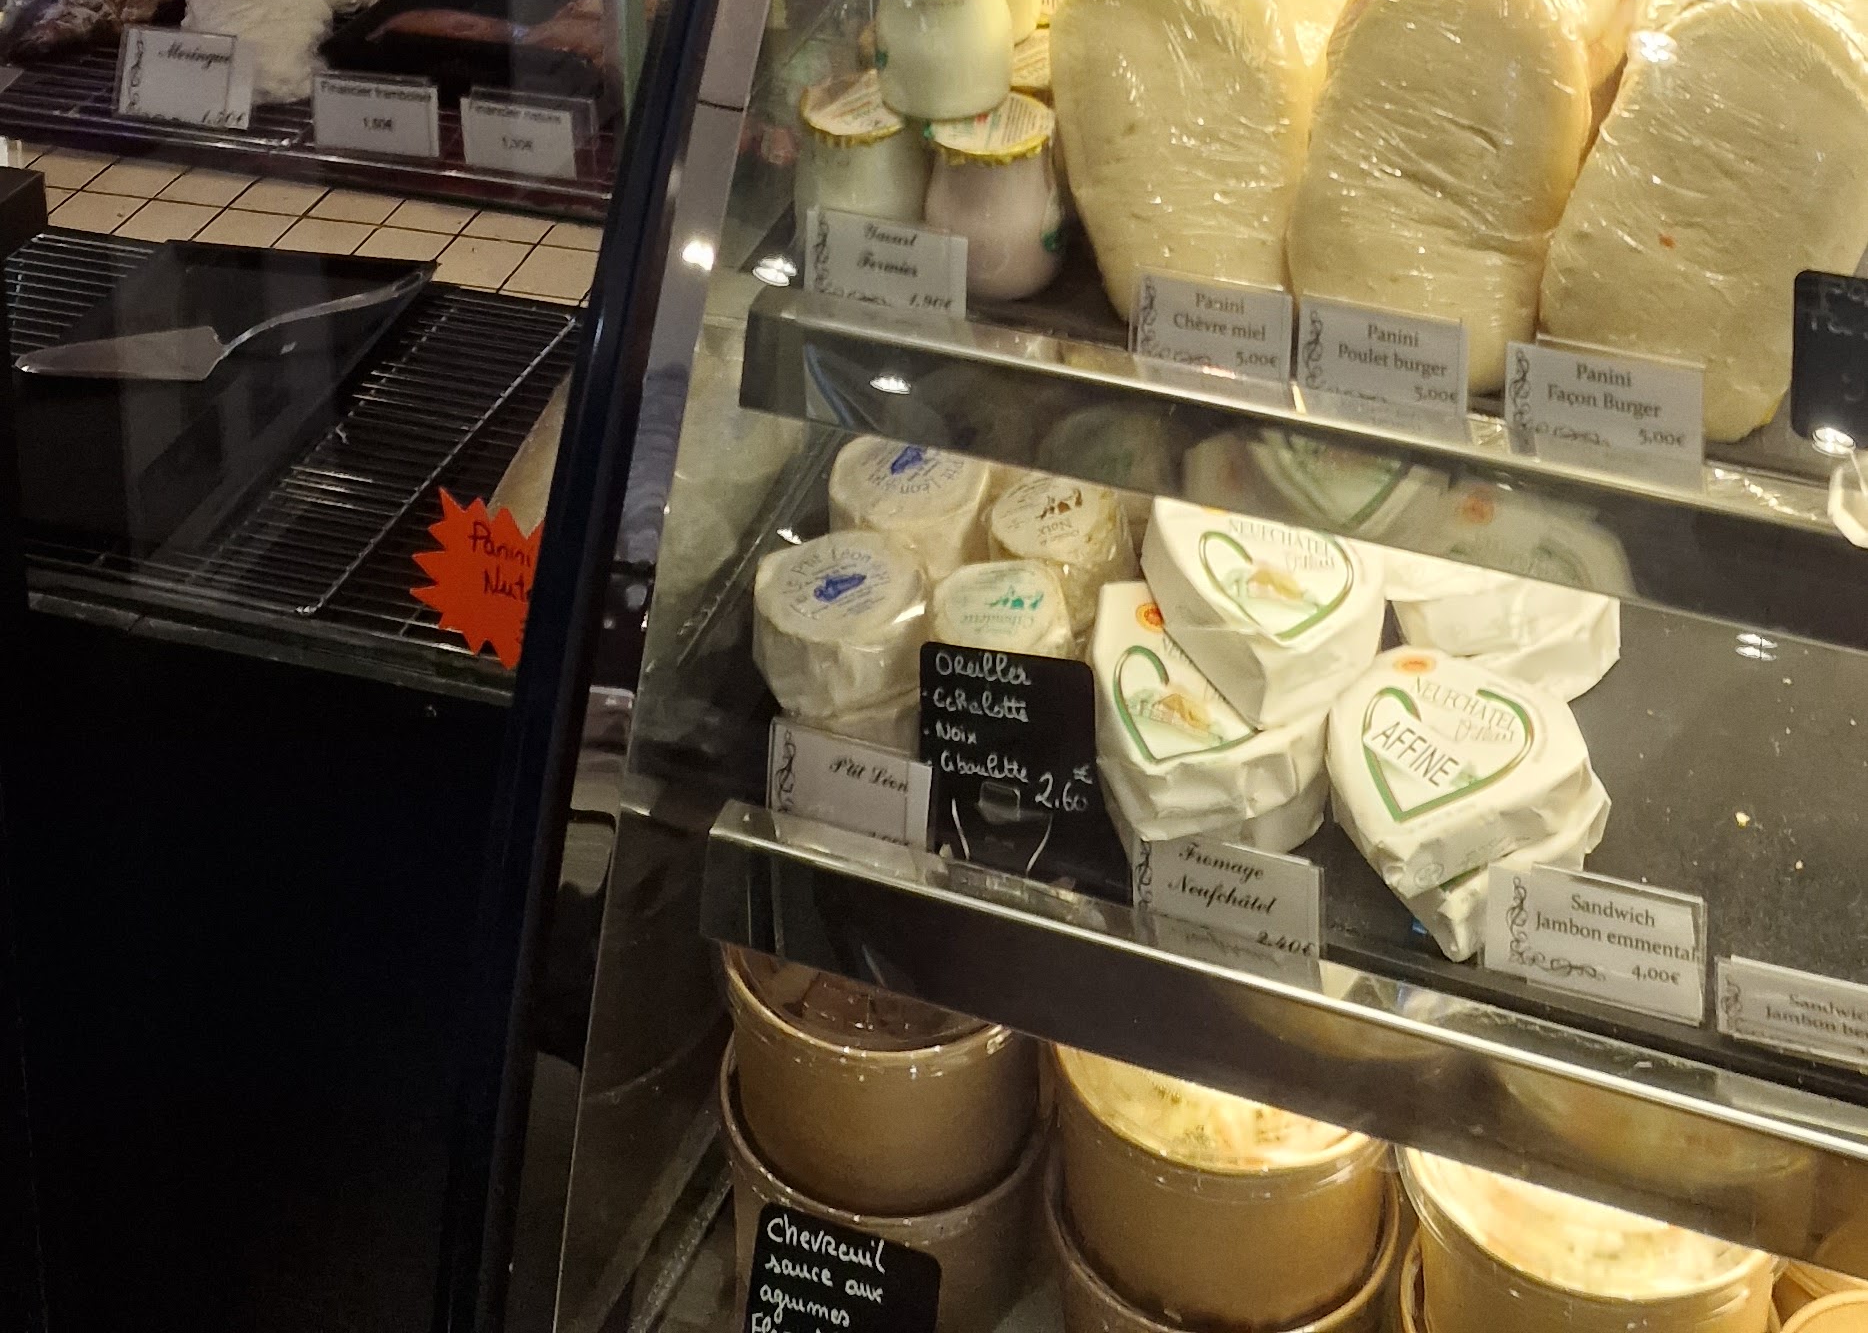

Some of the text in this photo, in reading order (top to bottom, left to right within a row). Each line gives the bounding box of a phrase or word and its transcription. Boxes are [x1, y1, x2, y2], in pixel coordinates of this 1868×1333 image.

[1195, 292, 1245, 315] Panini
[1232, 324, 1266, 342] miel
[1367, 323, 1419, 348] Panini
[1338, 342, 1448, 379] Poulet burger
[1575, 362, 1632, 388] Panini
[1547, 384, 1663, 421] Façon Burger
[468, 520, 531, 568] Panini
[935, 719, 978, 744] Noix
[1178, 841, 1265, 882] Fromage
[1166, 871, 1280, 915] Neufchâtel
[1570, 893, 1656, 929] Sandwich
[1535, 910, 1700, 963] Jambon emmental
[1765, 1006, 1836, 1034] Jambon
[1789, 993, 1868, 1023] Sandwic
[766, 1213, 886, 1275] Chevreuil
[764, 1253, 884, 1304] sauce aux
